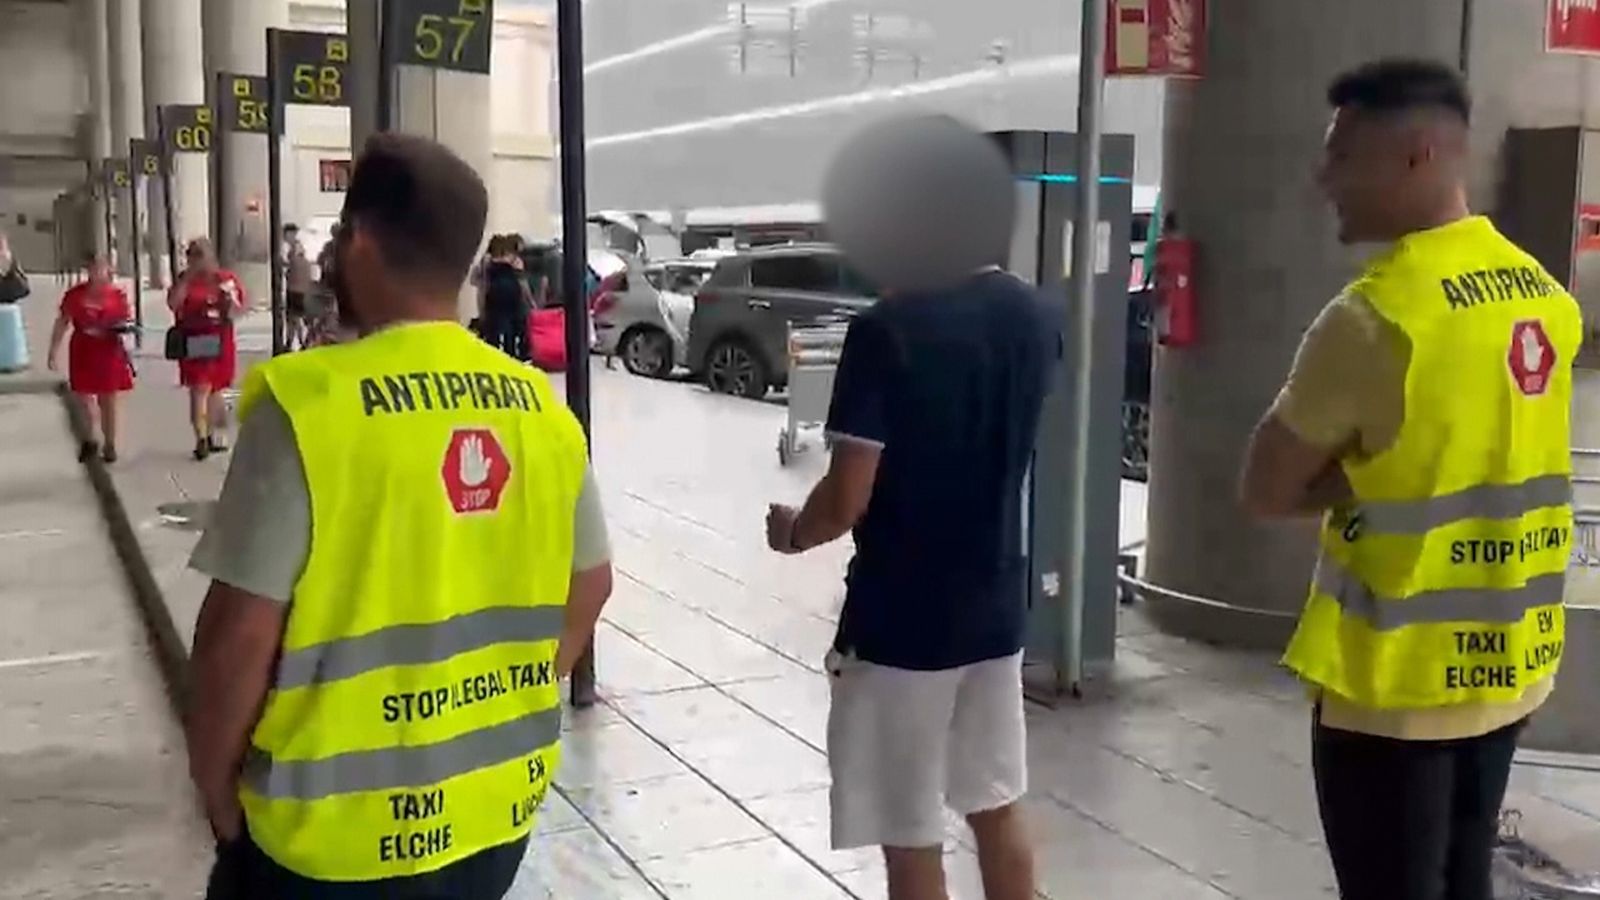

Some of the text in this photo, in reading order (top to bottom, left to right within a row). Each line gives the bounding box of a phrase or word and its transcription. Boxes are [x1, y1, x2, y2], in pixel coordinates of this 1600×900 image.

[416, 14, 475, 62] 57
[293, 64, 342, 100] 58
[176, 126, 210, 149] 60
[460, 489, 491, 509] STOP
[1450, 539, 1514, 564] STOP
[1454, 631, 1506, 655] TAXI
[1445, 665, 1516, 688] ELCHE
[382, 687, 448, 722] STOP
[388, 789, 443, 820] TAXI
[380, 823, 452, 862] ELCHE
